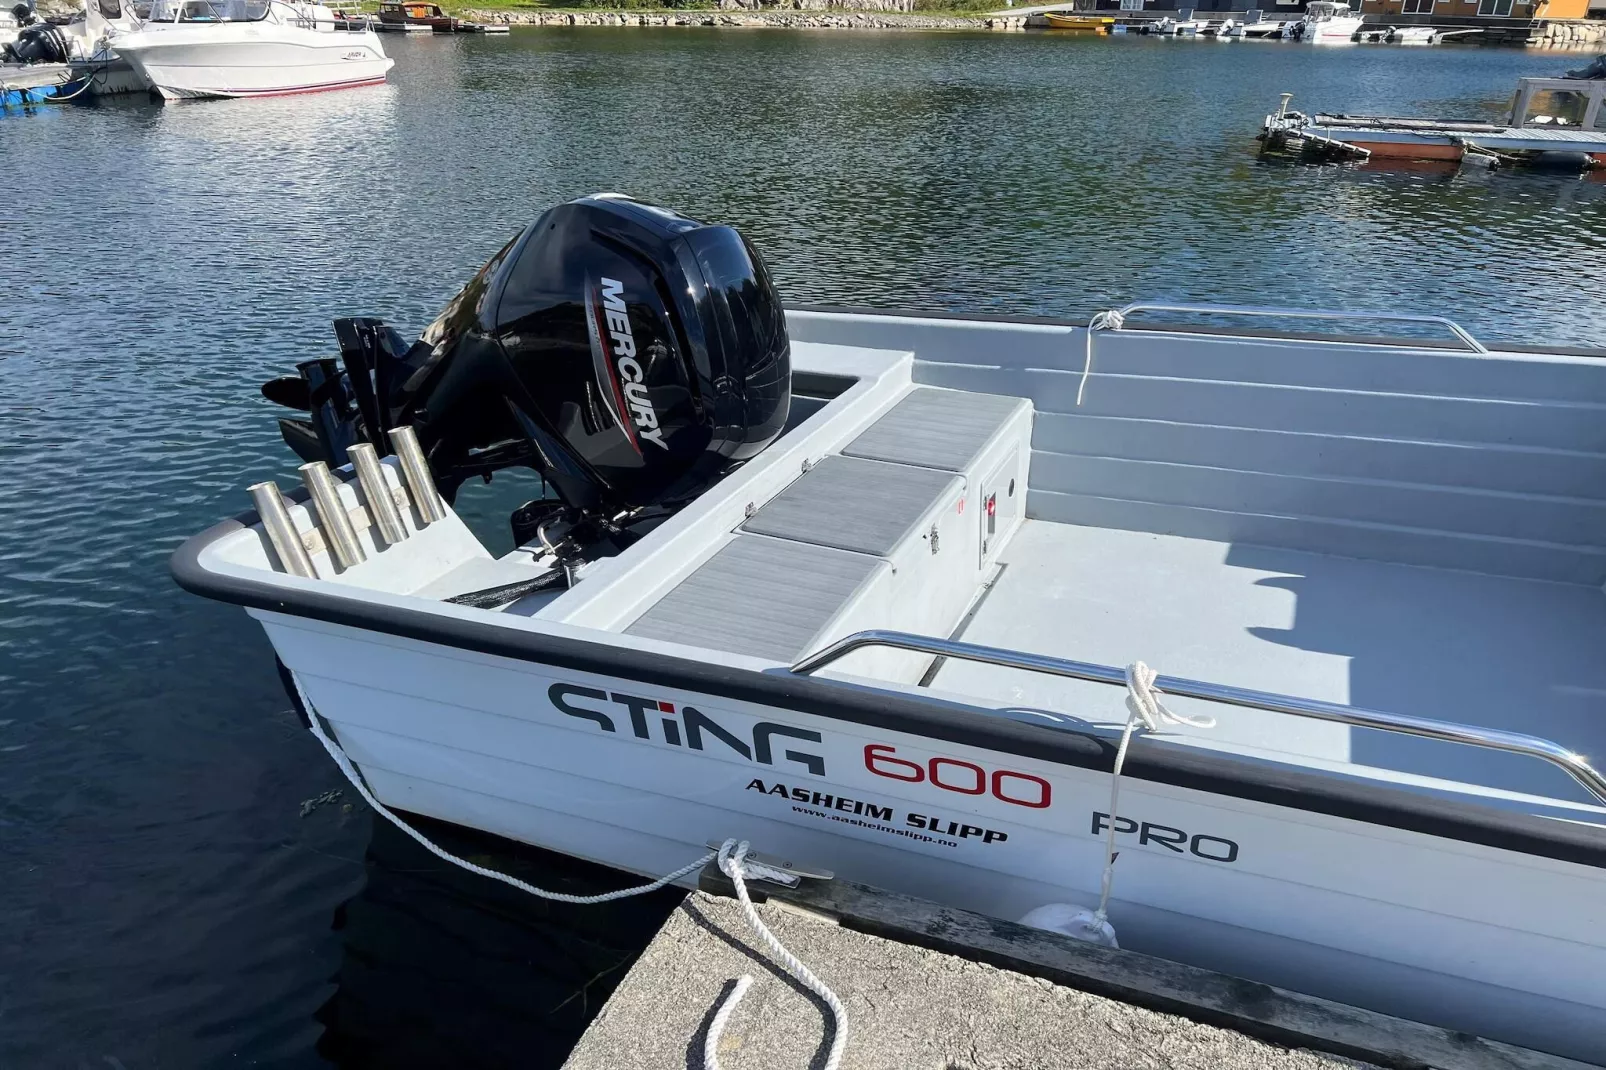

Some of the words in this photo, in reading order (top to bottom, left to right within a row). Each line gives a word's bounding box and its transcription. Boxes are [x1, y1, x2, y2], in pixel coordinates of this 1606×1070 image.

[601, 277, 669, 451] MERCURY
[863, 744, 1052, 809] 600
[745, 778, 894, 822] AASHEIM
[906, 812, 1008, 844] SLIPP
[791, 804, 958, 848] www.aasheimslipp.no
[1091, 811, 1239, 863] PRO
